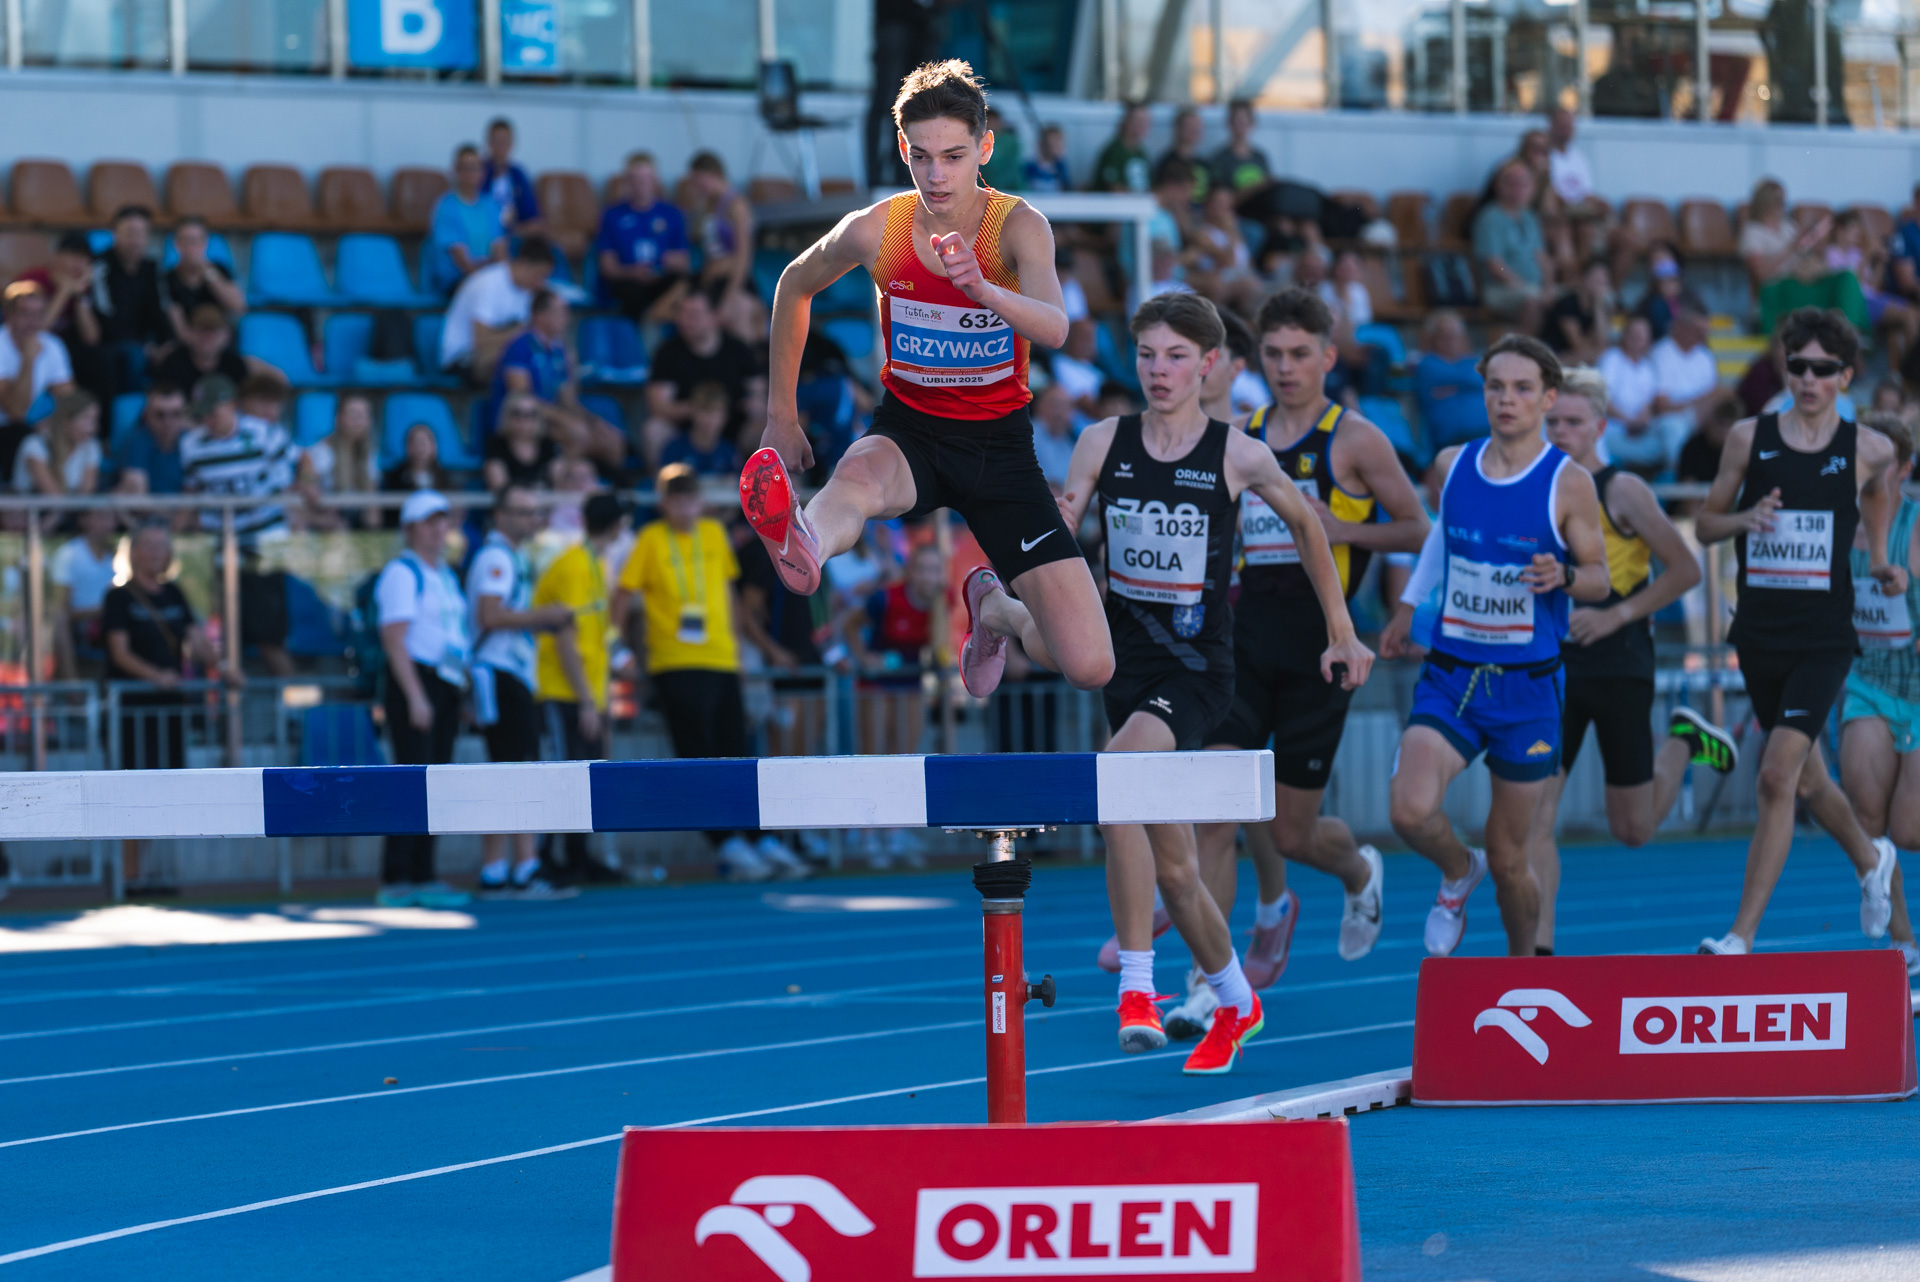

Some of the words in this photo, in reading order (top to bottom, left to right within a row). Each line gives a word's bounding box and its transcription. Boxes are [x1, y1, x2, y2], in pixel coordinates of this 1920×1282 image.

[889, 280, 914, 291] esa
[959, 313, 1003, 329] 632
[896, 333, 1009, 359] GRZYWACZ
[922, 376, 956, 384] LUBLIN
[1175, 468, 1217, 483] ORKAN
[1155, 518, 1205, 537] 1032
[1124, 547, 1183, 572] GOLA
[1751, 540, 1828, 563] ZAWIEJA
[1452, 590, 1527, 617] OLEJNIK
[1633, 1002, 1831, 1045] ORLEN
[937, 1199, 1232, 1261] ORLEN
